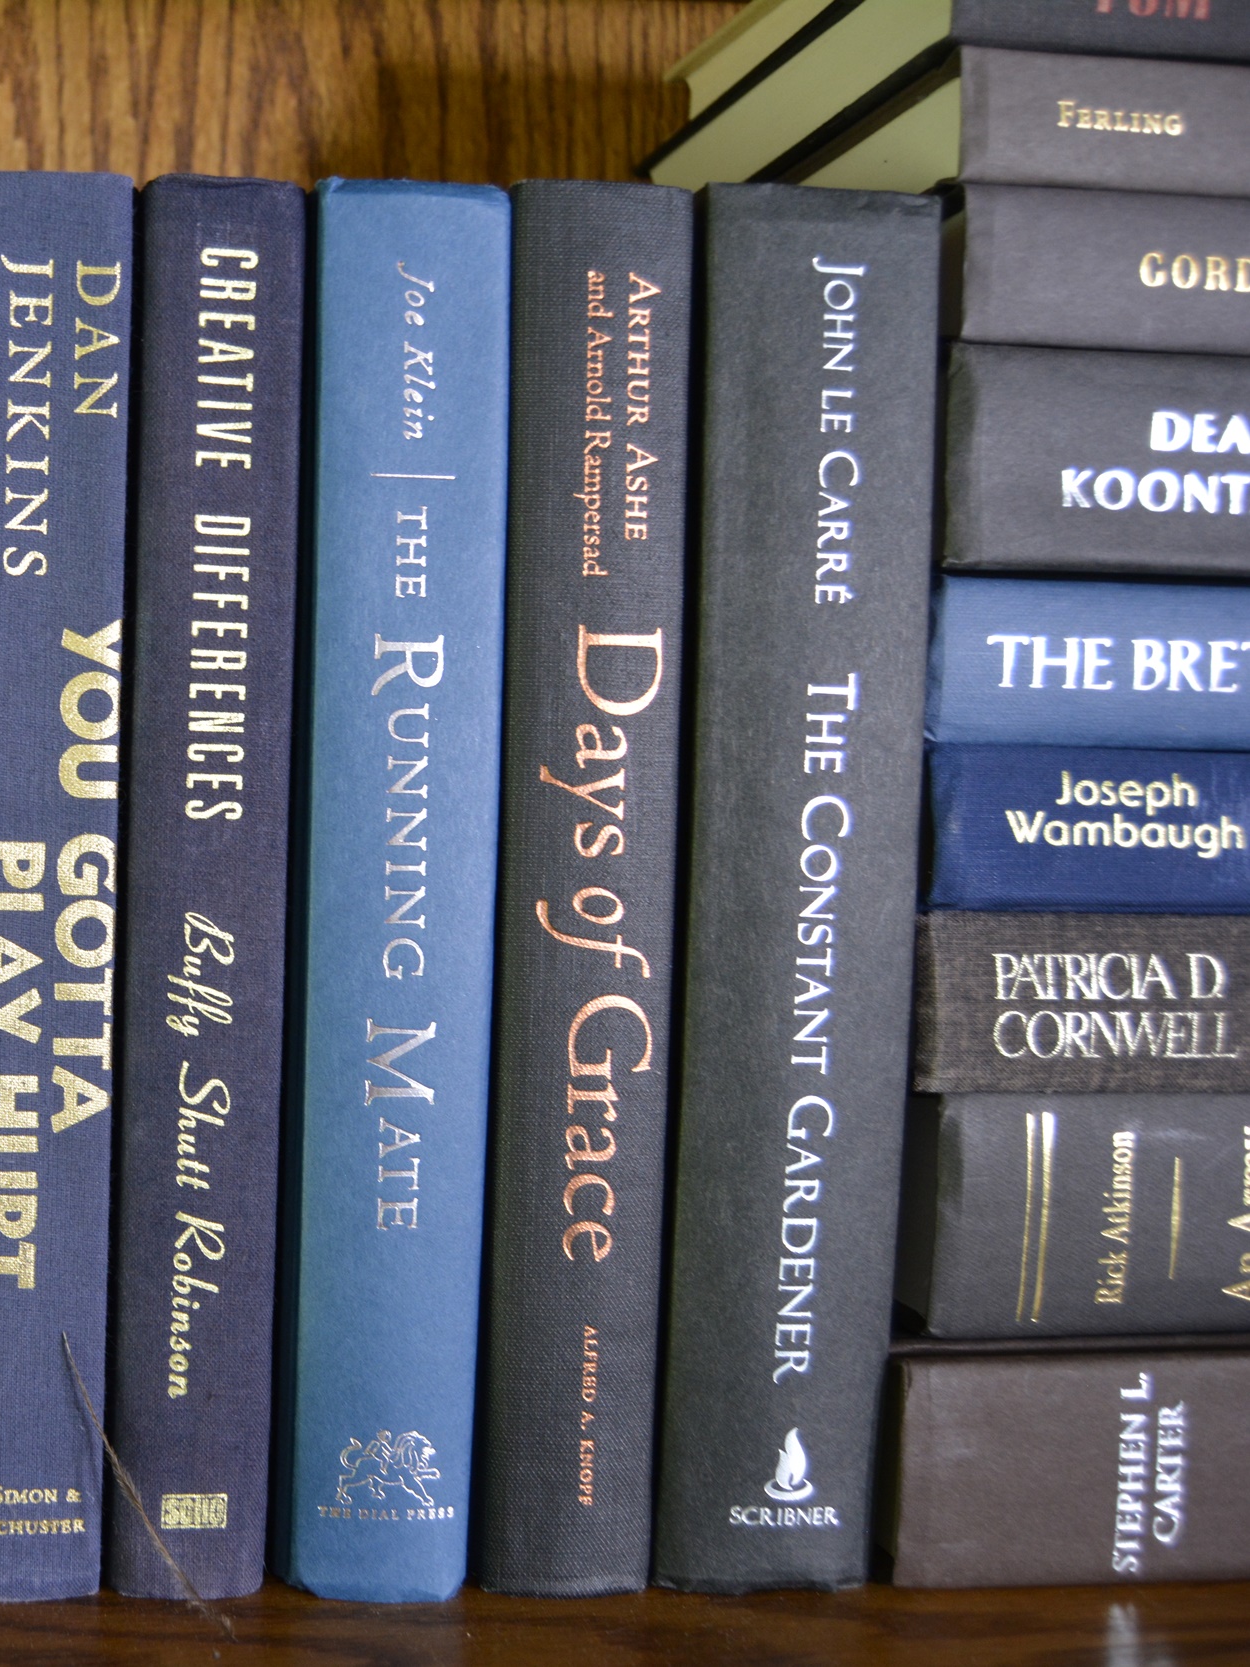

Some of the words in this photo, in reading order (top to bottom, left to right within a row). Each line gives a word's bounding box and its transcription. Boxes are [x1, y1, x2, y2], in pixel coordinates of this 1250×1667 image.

[73, 260, 121, 418] DAN
[397, 260, 435, 326] Joe
[587, 270, 614, 318] and
[626, 271, 661, 426] ARTHUR
[812, 256, 865, 372] JOHN
[195, 247, 258, 470] CREATIVE
[402, 341, 436, 440] Klein
[585, 326, 612, 422] Arnold
[820, 389, 852, 433] LE
[0, 254, 54, 578] JENKINS
[574, 430, 611, 577] Rampersad
[624, 443, 659, 541] ASHE
[815, 450, 860, 604] CARRÉ
[396, 506, 428, 598] THE
[58, 619, 122, 799] YOU
[183, 514, 251, 820] DIFFERENCES
[987, 634, 1114, 691] THE
[1131, 639, 1250, 693] BRE
[540, 625, 662, 857] Days
[804, 673, 857, 773] THE
[1006, 810, 1246, 858] Wambaugh
[1055, 770, 1197, 815] Joseph
[51, 832, 118, 1134] GOTTA
[167, 911, 236, 1037] Buffy
[536, 886, 650, 978] of
[791, 795, 850, 1075] CONSTANT
[992, 952, 1177, 1000] PATRICIA
[993, 1010, 1241, 1058] CORNWELL
[176, 1060, 231, 1190] Shutt
[562, 995, 652, 1262] Grace
[773, 1095, 834, 1384] GARDENER
[1101, 1131, 1136, 1244] Atkinson
[167, 1211, 227, 1399] Robinson
[1094, 1250, 1128, 1304] Rick
[581, 1325, 598, 1402] ALFRED
[66, 1488, 82, 1503] &
[317, 1505, 352, 1519] THE
[358, 1508, 399, 1521] DIAL
[406, 1506, 455, 1521] PRESS
[729, 1506, 840, 1527] SCRIBNER
[1112, 1412, 1148, 1575] STEPHEN
[1153, 1400, 1185, 1543] CARTER
